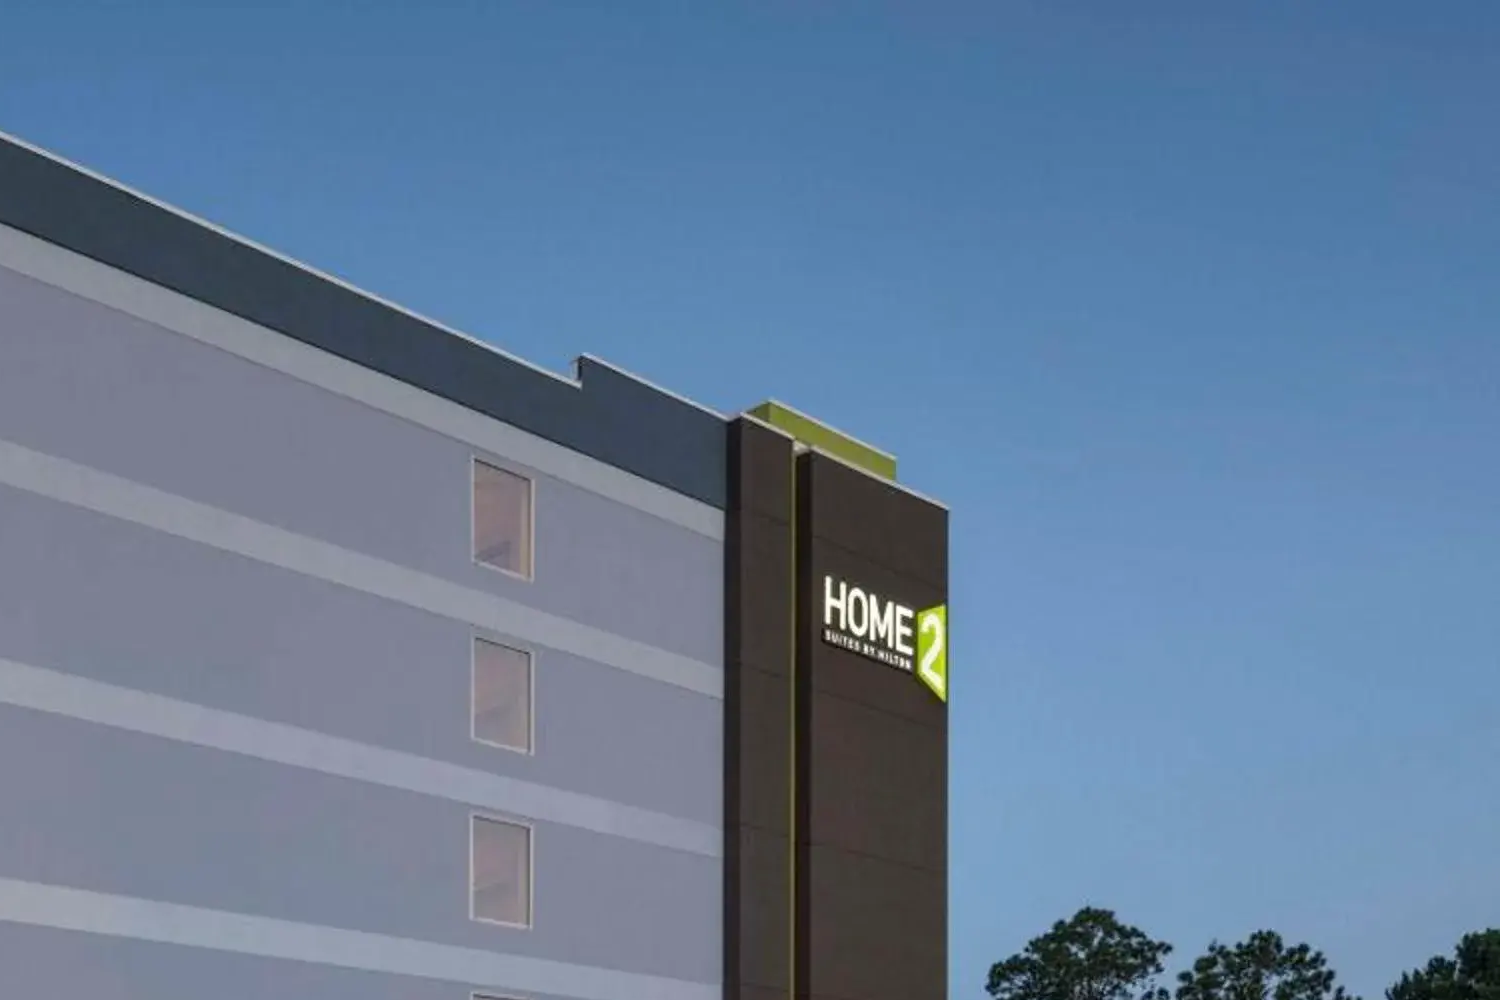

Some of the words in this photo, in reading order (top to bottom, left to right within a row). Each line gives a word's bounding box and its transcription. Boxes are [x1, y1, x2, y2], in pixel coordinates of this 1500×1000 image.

[824, 629, 860, 651] SUITES
[863, 643, 875, 655] BY
[877, 650, 912, 670] HILTON
